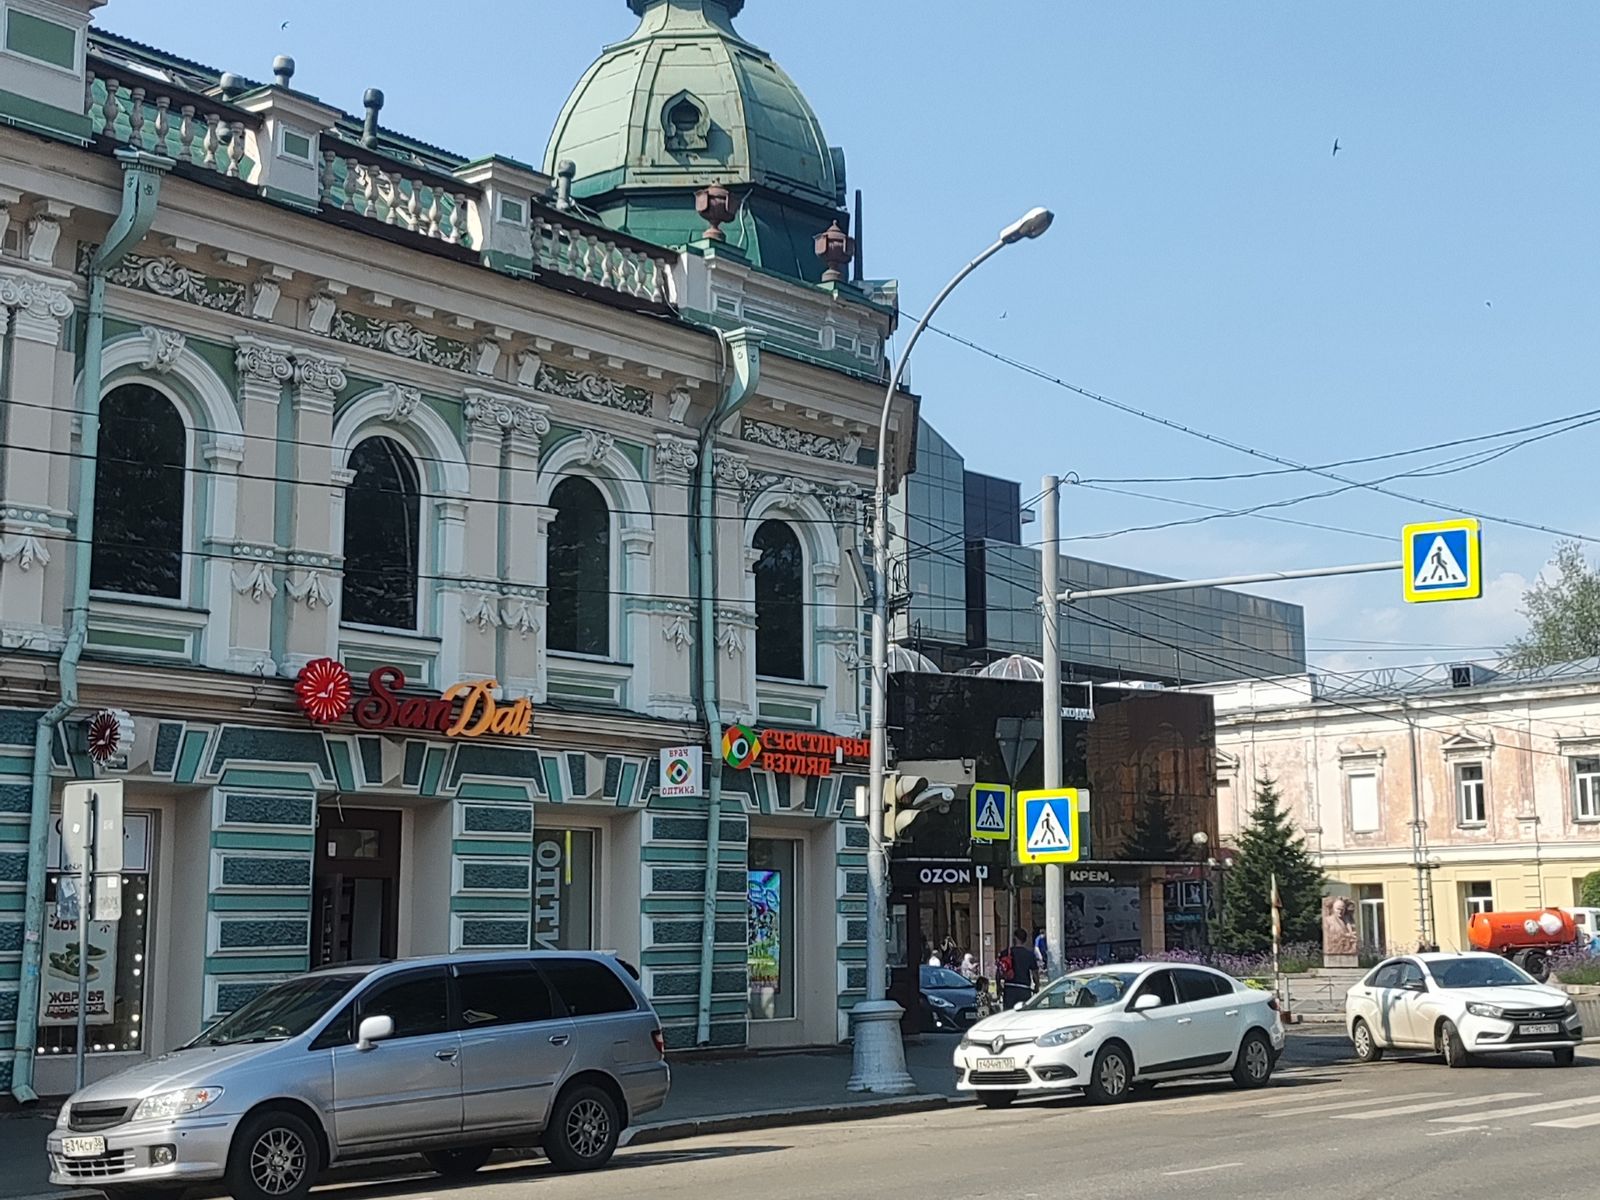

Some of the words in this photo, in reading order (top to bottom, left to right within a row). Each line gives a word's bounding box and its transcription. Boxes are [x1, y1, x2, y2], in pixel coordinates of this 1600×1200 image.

[761, 729, 871, 758] СЧАСТЛИВЫ
[669, 748, 689, 757] ВРАЧ
[762, 752, 831, 776] ВЗГЛЯД
[662, 785, 695, 795] ОПТИКА
[919, 868, 971, 884] OZON
